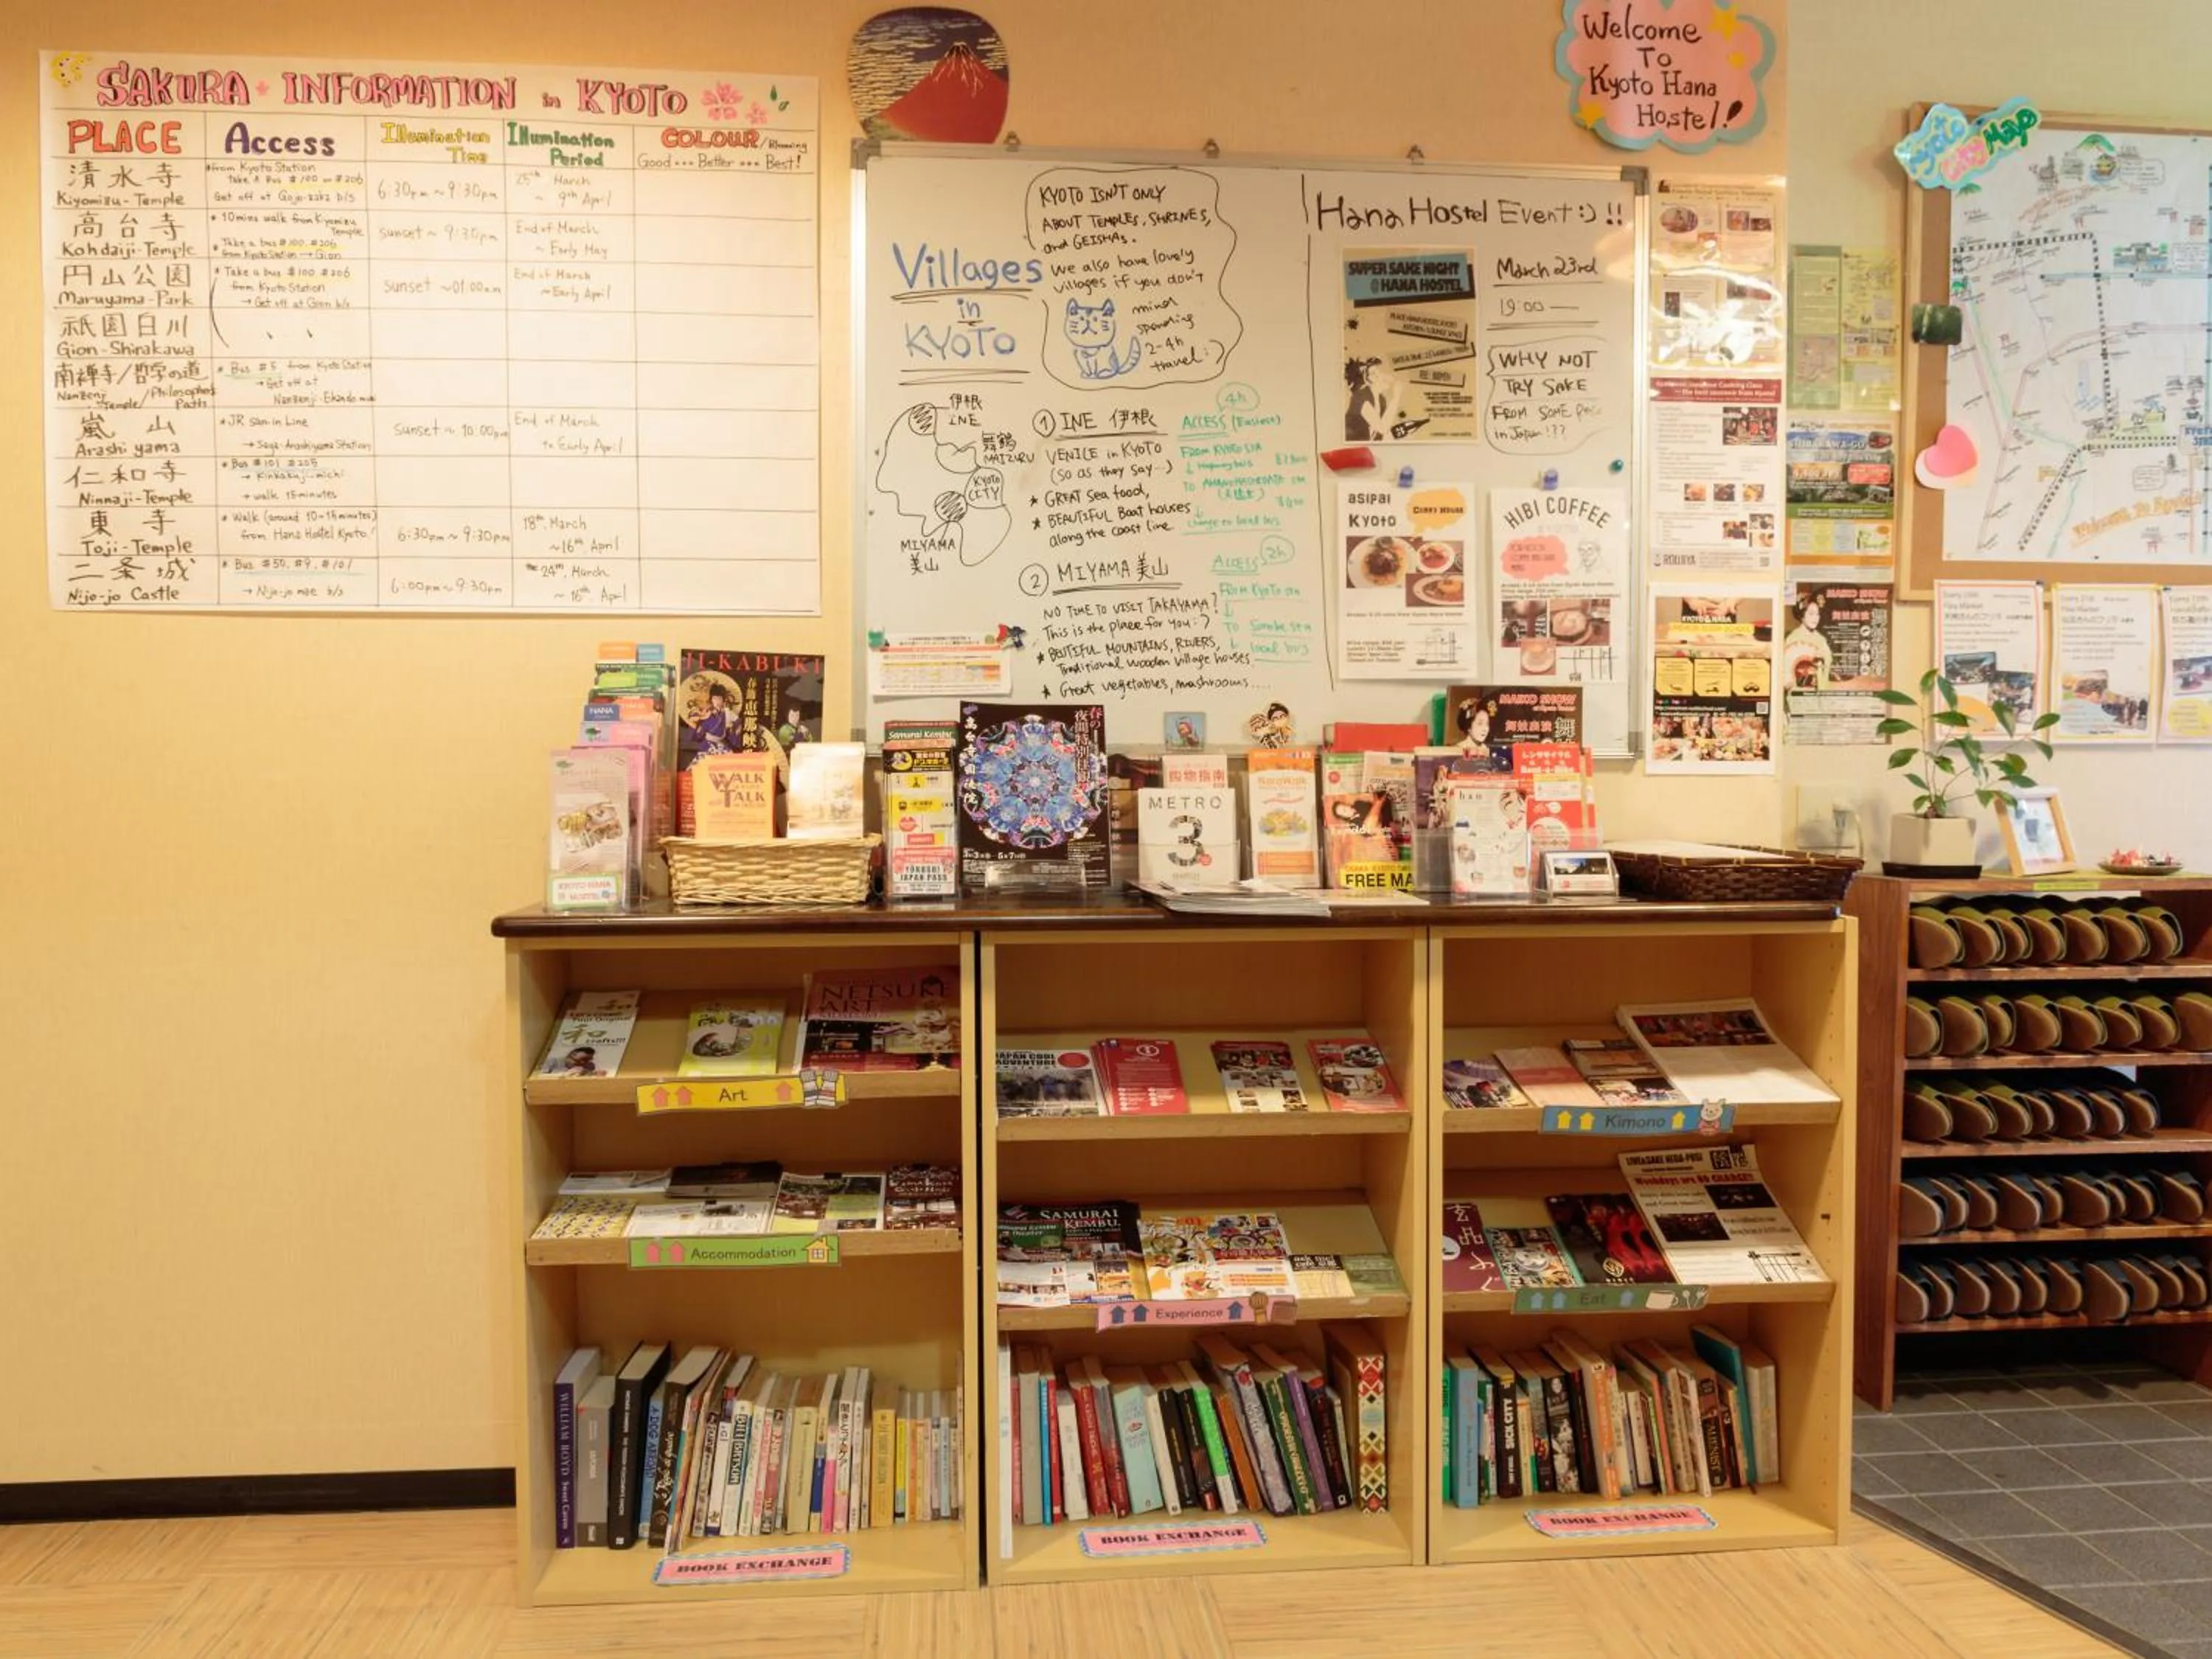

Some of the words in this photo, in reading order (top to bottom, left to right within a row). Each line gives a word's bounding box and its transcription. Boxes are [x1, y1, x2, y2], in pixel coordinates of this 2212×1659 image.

[1583, 3, 1703, 43] Welcome
[1636, 46, 1672, 68] To
[97, 60, 250, 107] SAKURA
[282, 71, 517, 110] INFORMATION
[541, 92, 561, 108] in
[576, 77, 688, 116] KYOTO
[1589, 63, 1654, 100] Kyoto
[1660, 70, 1717, 97] Hana
[1636, 100, 1743, 131] Hostel!
[67, 119, 183, 154] PLACE
[224, 121, 335, 156] Access
[380, 122, 490, 144] Illumination
[507, 121, 615, 147] Illumination
[661, 128, 760, 149] COLOUR
[1982, 108, 2037, 156] Map
[549, 147, 604, 167] Period
[638, 153, 671, 169] Good
[697, 153, 736, 169] Better
[765, 153, 802, 170] Best!
[68, 160, 182, 189] 清水寺
[1039, 185, 1084, 207] KYOTO
[1132, 184, 1166, 203] ONLY
[1316, 190, 1405, 231] Hana
[1409, 196, 1488, 225] Hostel
[1498, 198, 1573, 225] Event
[73, 211, 185, 240] 高台寺
[1042, 214, 1082, 233] ABOUT
[1043, 238, 1068, 254] and
[892, 242, 1043, 291] Villages
[1082, 259, 1110, 273] also
[1116, 254, 1150, 268] have
[1348, 261, 1388, 276] SUPER
[1388, 261, 1423, 276] SAKE
[1422, 260, 1460, 276] NIGHT
[1497, 257, 1549, 279] March
[1554, 256, 1599, 276] 23rd
[62, 263, 191, 288] 円山公園
[1113, 273, 1130, 289] if
[1134, 277, 1162, 291] you
[1381, 278, 1418, 293] HANA
[1419, 277, 1464, 292] HOSTEL
[956, 297, 981, 320] in
[1499, 350, 1548, 369] WHY
[1559, 349, 1599, 369] NOT
[1503, 378, 1534, 397] TRY
[1543, 378, 1587, 396] SAKE
[949, 413, 981, 427] INE
[1060, 411, 1098, 432] INE
[1492, 405, 1528, 420] FROM
[1539, 403, 1573, 422] SOME
[1046, 447, 1099, 465] VENICE
[63, 459, 187, 488] 仁和寺
[968, 487, 1001, 502] CITY
[1044, 489, 1081, 508] GREAT
[1147, 501, 1192, 515] houses
[1503, 498, 1541, 530] HIBI
[1545, 495, 1613, 529] COFFEE
[80, 509, 176, 539] 東寺
[900, 538, 956, 552] MIYAMA
[1057, 559, 1131, 582] MIYAMA
[131, 585, 180, 602] Castle
[1096, 602, 1107, 615] TO
[1043, 625, 1069, 642] This
[1147, 796, 1223, 810] METRO
[1168, 814, 1203, 867] 3
[1345, 872, 1386, 888] FREE
[718, 1086, 749, 1103] Art
[1604, 1113, 1667, 1130] Kimono
[1040, 1208, 1120, 1220] SAMURAI
[689, 1245, 796, 1262] Accommodation
[1578, 1292, 1607, 1306] Eat
[1155, 1305, 1225, 1321] Experience
[560, 1392, 571, 1441] WILLIAM
[1503, 1397, 1514, 1422] CITY
[732, 1413, 748, 1441] BILL
[560, 1444, 571, 1476] BOYD
[727, 1441, 748, 1486] BRYSON
[1550, 1514, 1598, 1526] BOOK
[1602, 1509, 1695, 1523] EXCHANGE
[1100, 1534, 1150, 1546] BOOK
[1155, 1527, 1249, 1541] EXCHANGE
[675, 1562, 730, 1574] BOOK
[736, 1555, 833, 1571] EXCHANGE
